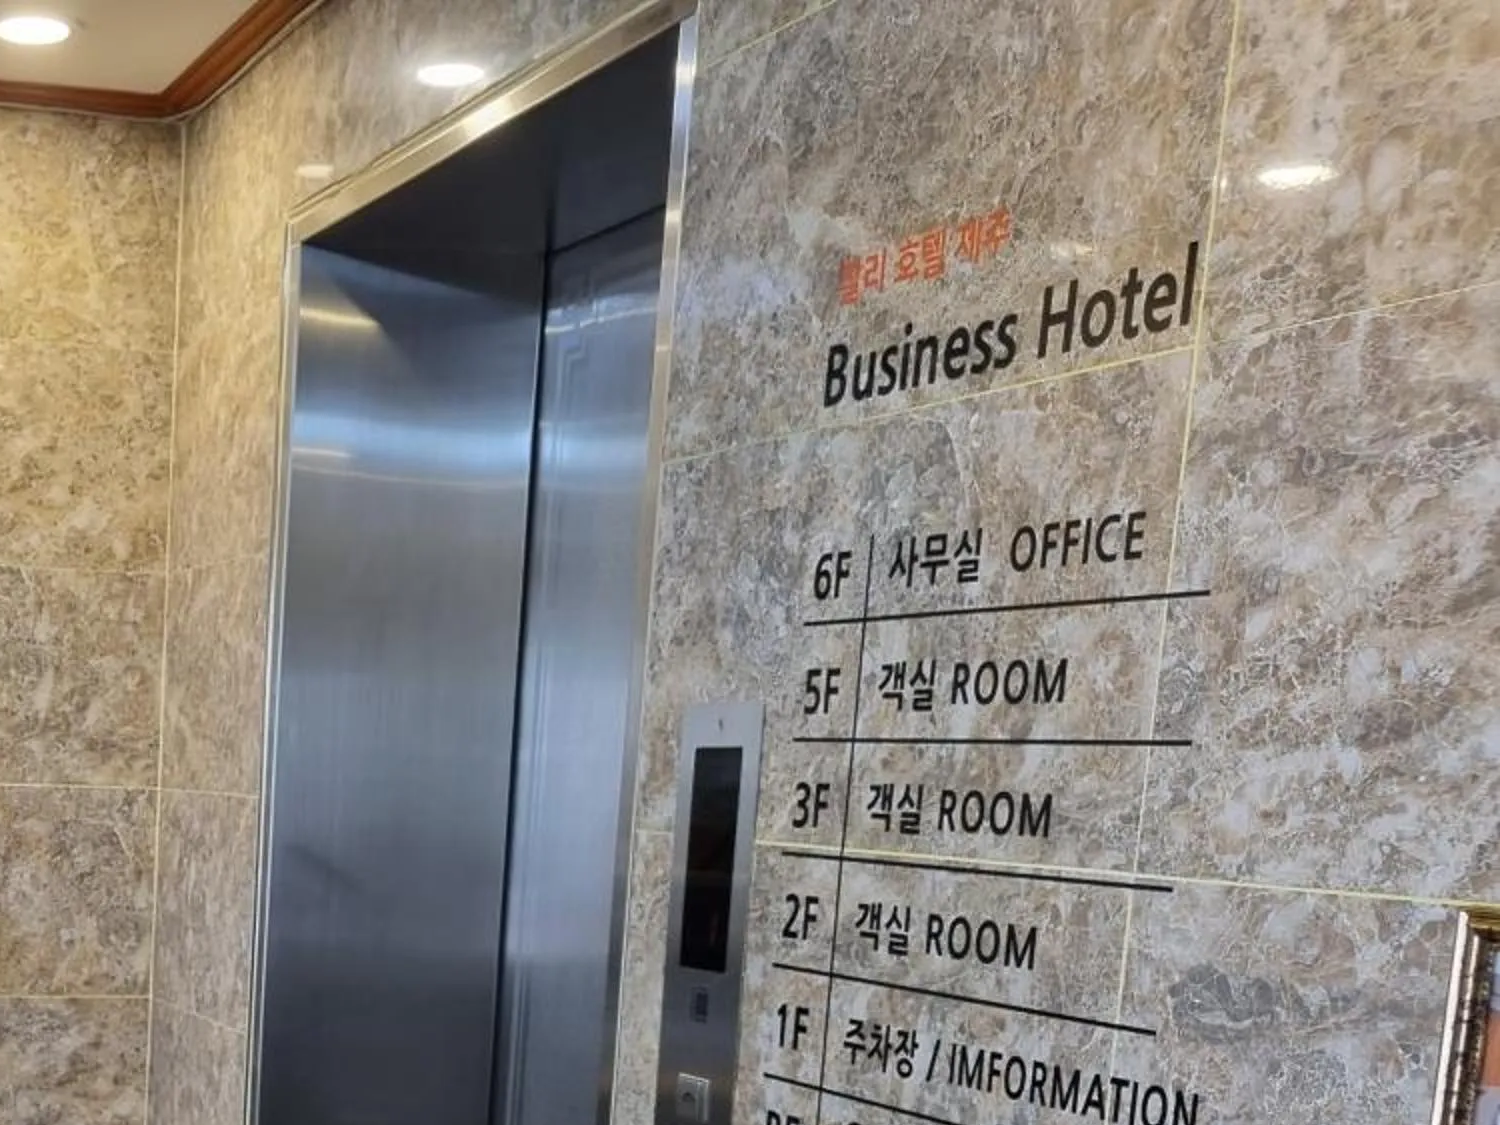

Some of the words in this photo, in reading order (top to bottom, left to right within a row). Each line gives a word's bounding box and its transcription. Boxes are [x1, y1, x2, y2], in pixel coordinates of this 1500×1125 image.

[894, 224, 946, 285] 호텔
[823, 313, 1018, 409] Business
[1037, 240, 1200, 361] Hotel
[813, 549, 853, 600] 6F
[888, 526, 984, 589] 사무실
[1010, 511, 1147, 573] OFFICE
[803, 666, 842, 716] 5F
[877, 657, 936, 713] 객실
[950, 658, 1069, 705] ROOM
[791, 782, 831, 829] 3F
[866, 782, 923, 836] 객실
[937, 789, 1053, 838] ROOM
[781, 893, 820, 942] 2F
[854, 900, 912, 957] 객실
[925, 913, 1039, 971] ROOM
[775, 1002, 811, 1052] 1F
[842, 1018, 920, 1082] 주차장
